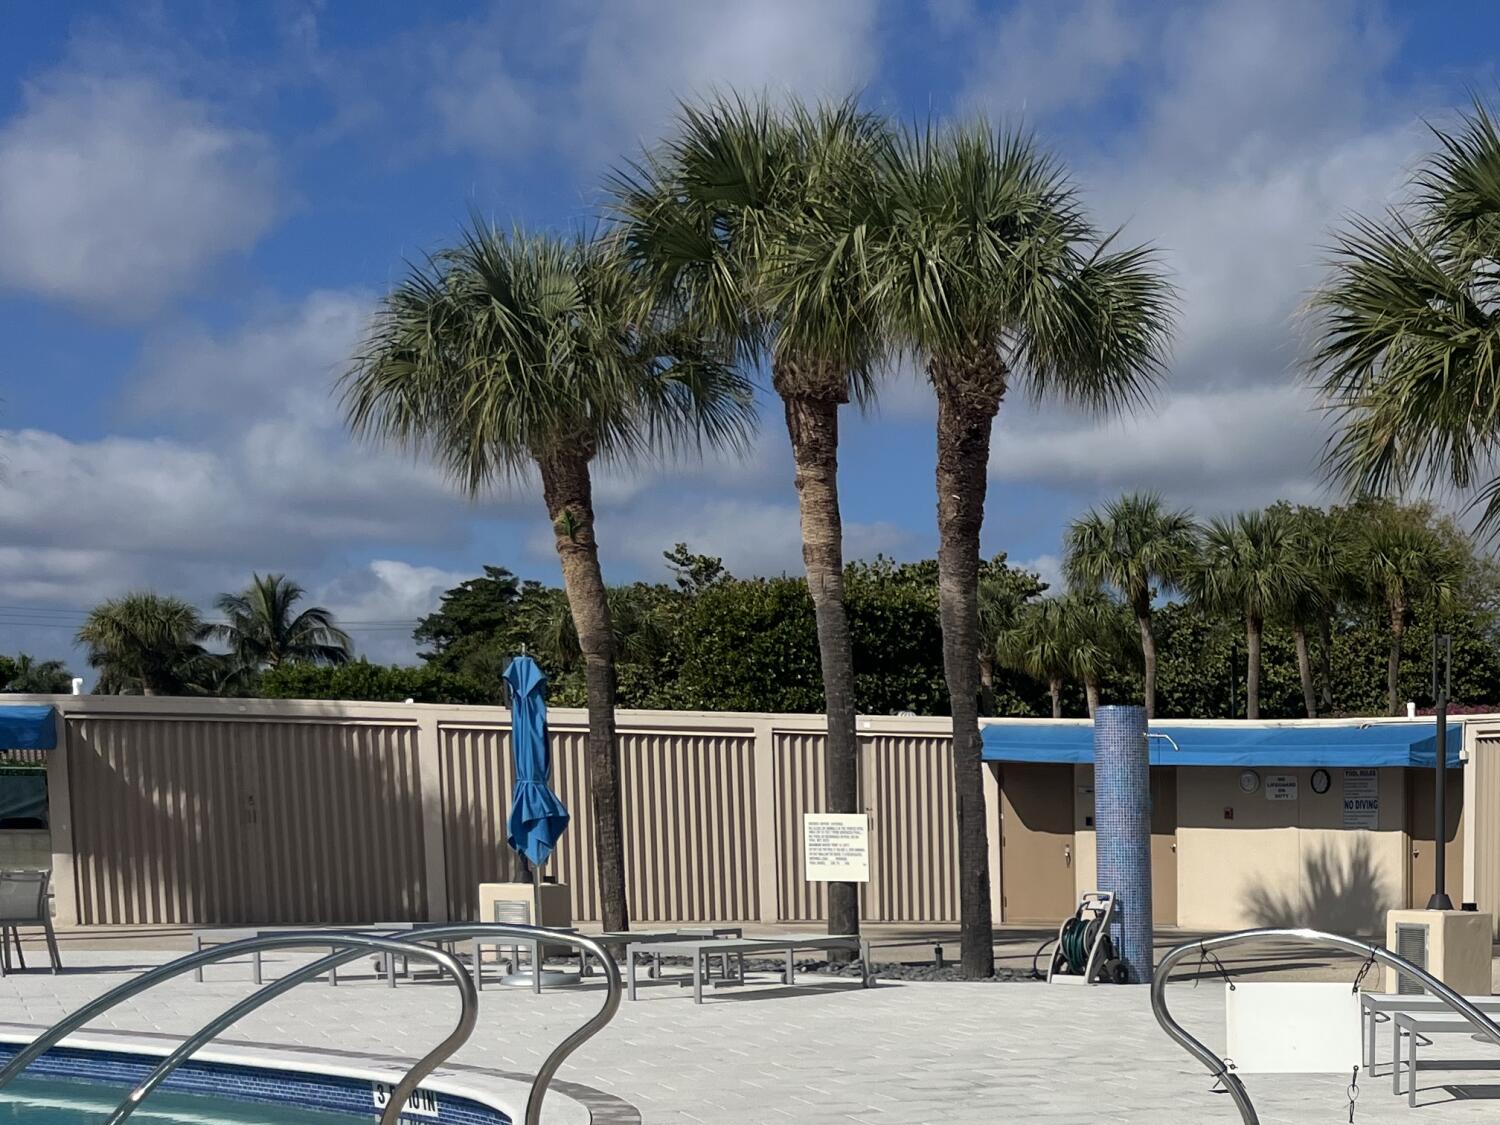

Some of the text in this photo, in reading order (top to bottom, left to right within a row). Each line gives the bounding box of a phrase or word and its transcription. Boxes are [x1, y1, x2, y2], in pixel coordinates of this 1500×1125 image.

[1344, 799, 1378, 809] NO DIVING
[377, 1084, 386, 1104] 3
[421, 1090, 436, 1112] IN
